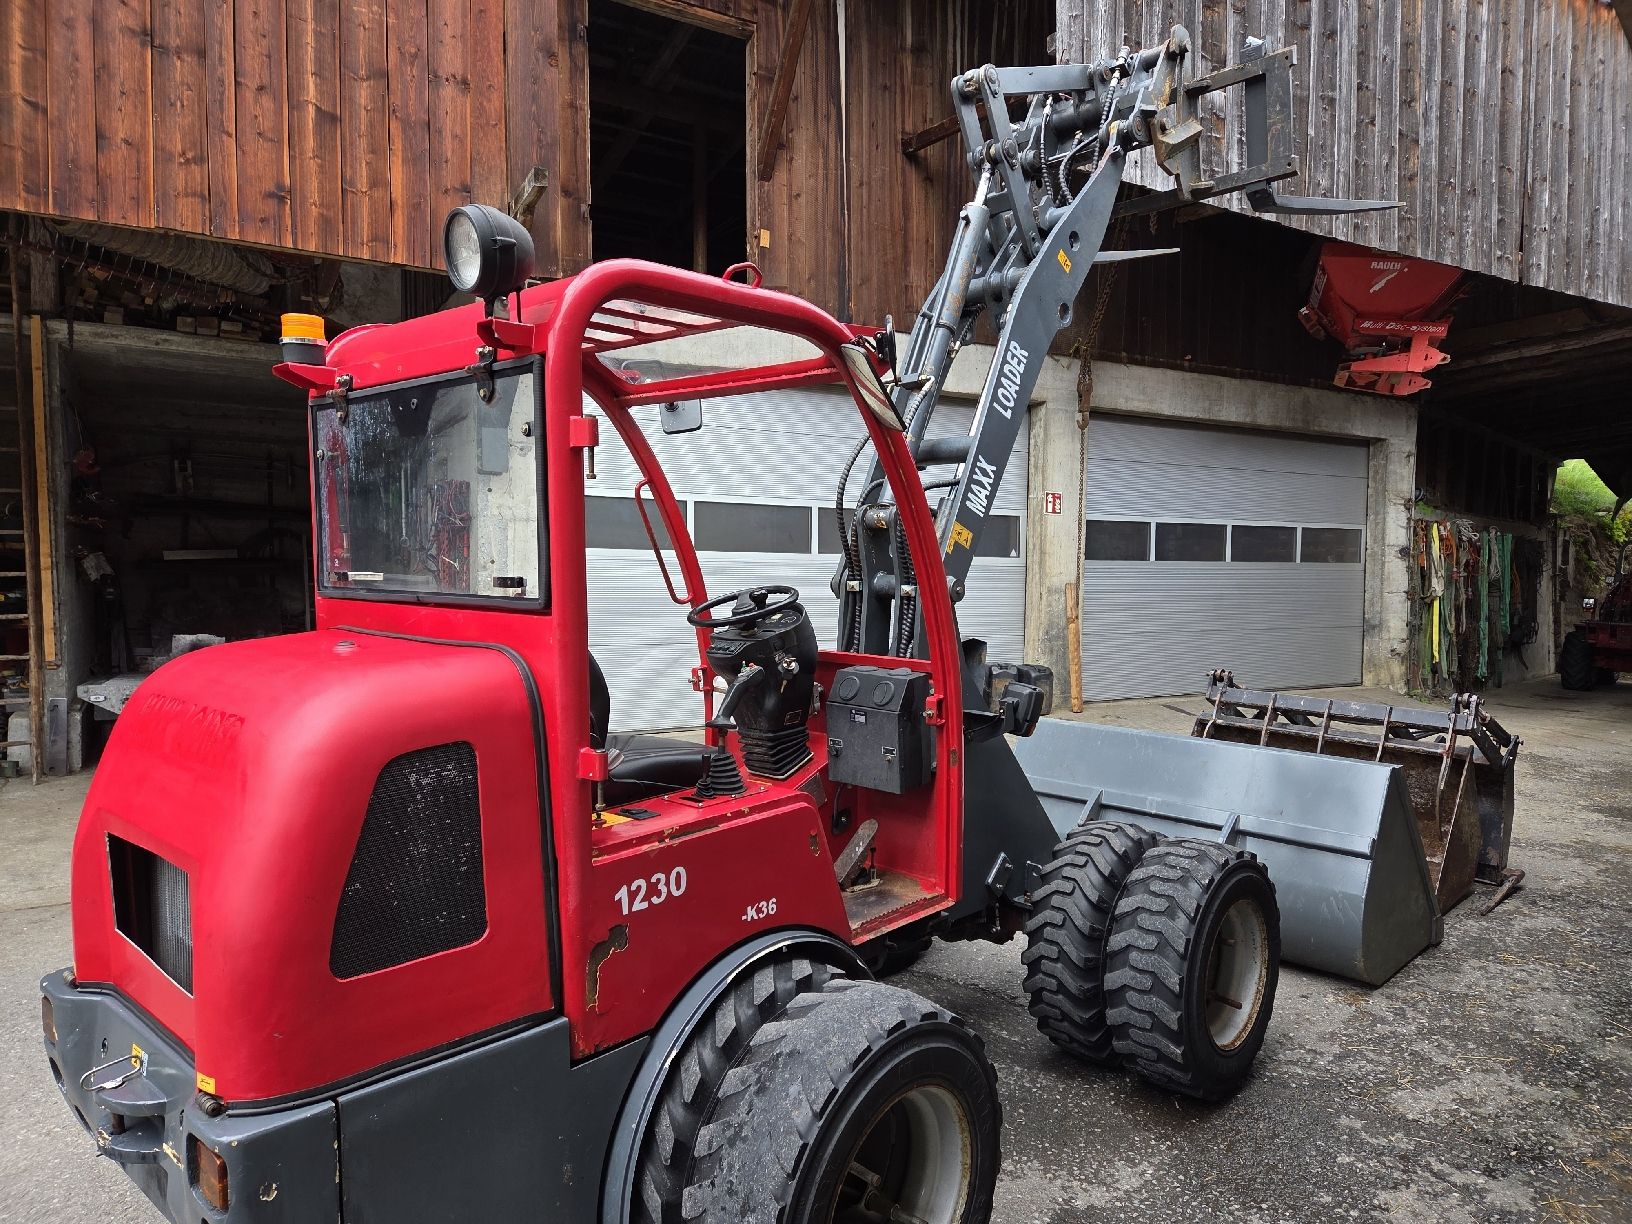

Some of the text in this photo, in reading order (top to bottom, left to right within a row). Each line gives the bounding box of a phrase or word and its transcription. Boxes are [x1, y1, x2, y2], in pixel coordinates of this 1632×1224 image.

[1370, 261, 1402, 270] RAUCH
[966, 340, 1029, 518] MAXX LOADER
[614, 866, 687, 916] 1230
[741, 897, 777, 922] -K36
